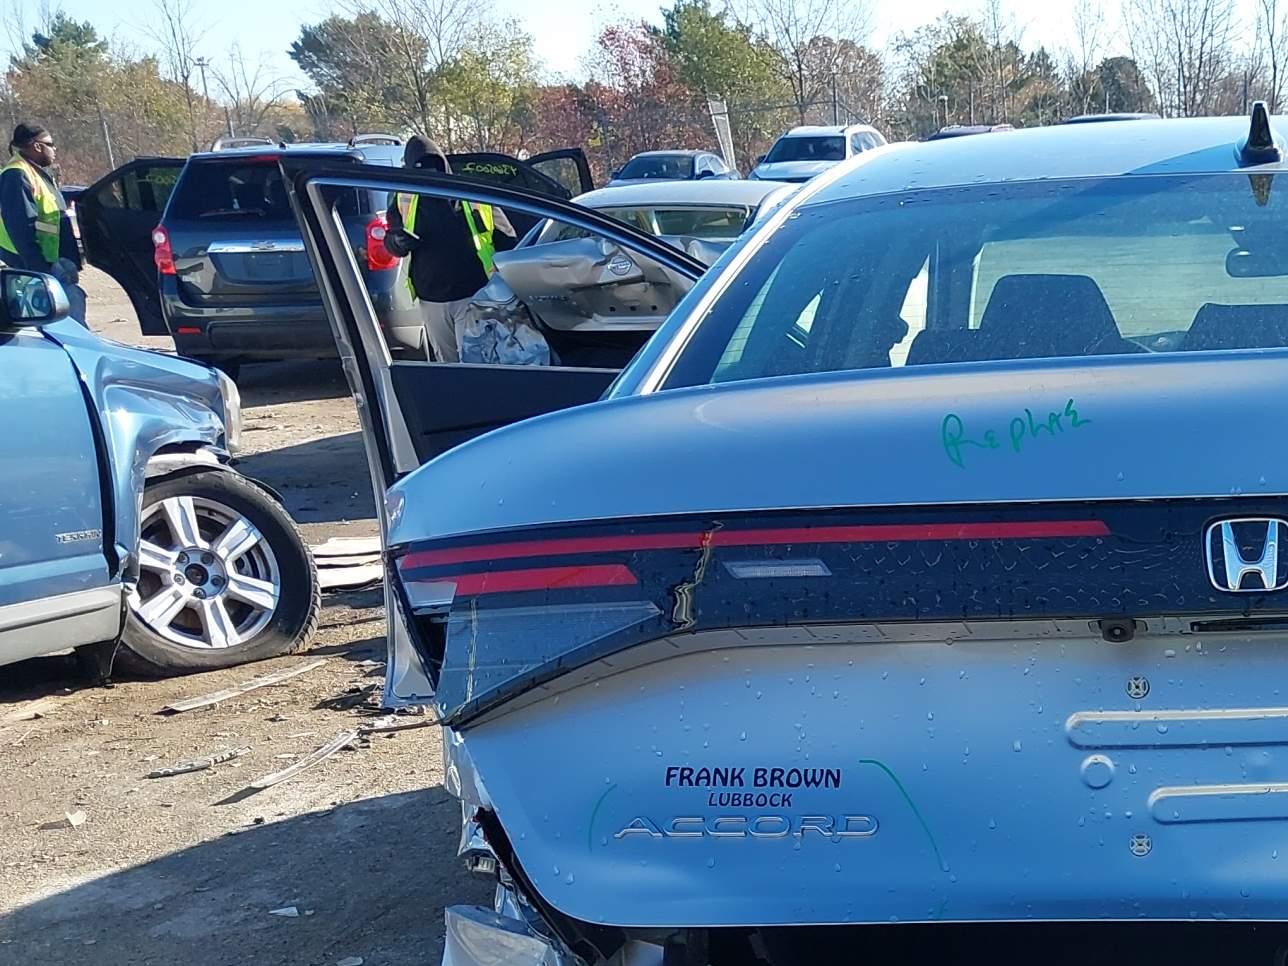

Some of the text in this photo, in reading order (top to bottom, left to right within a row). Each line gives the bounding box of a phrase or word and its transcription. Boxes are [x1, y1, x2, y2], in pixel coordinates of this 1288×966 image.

[665, 766, 841, 788] FRANK BROWN
[708, 792, 793, 807] LUBBOCK
[613, 814, 880, 839] ACCORD
